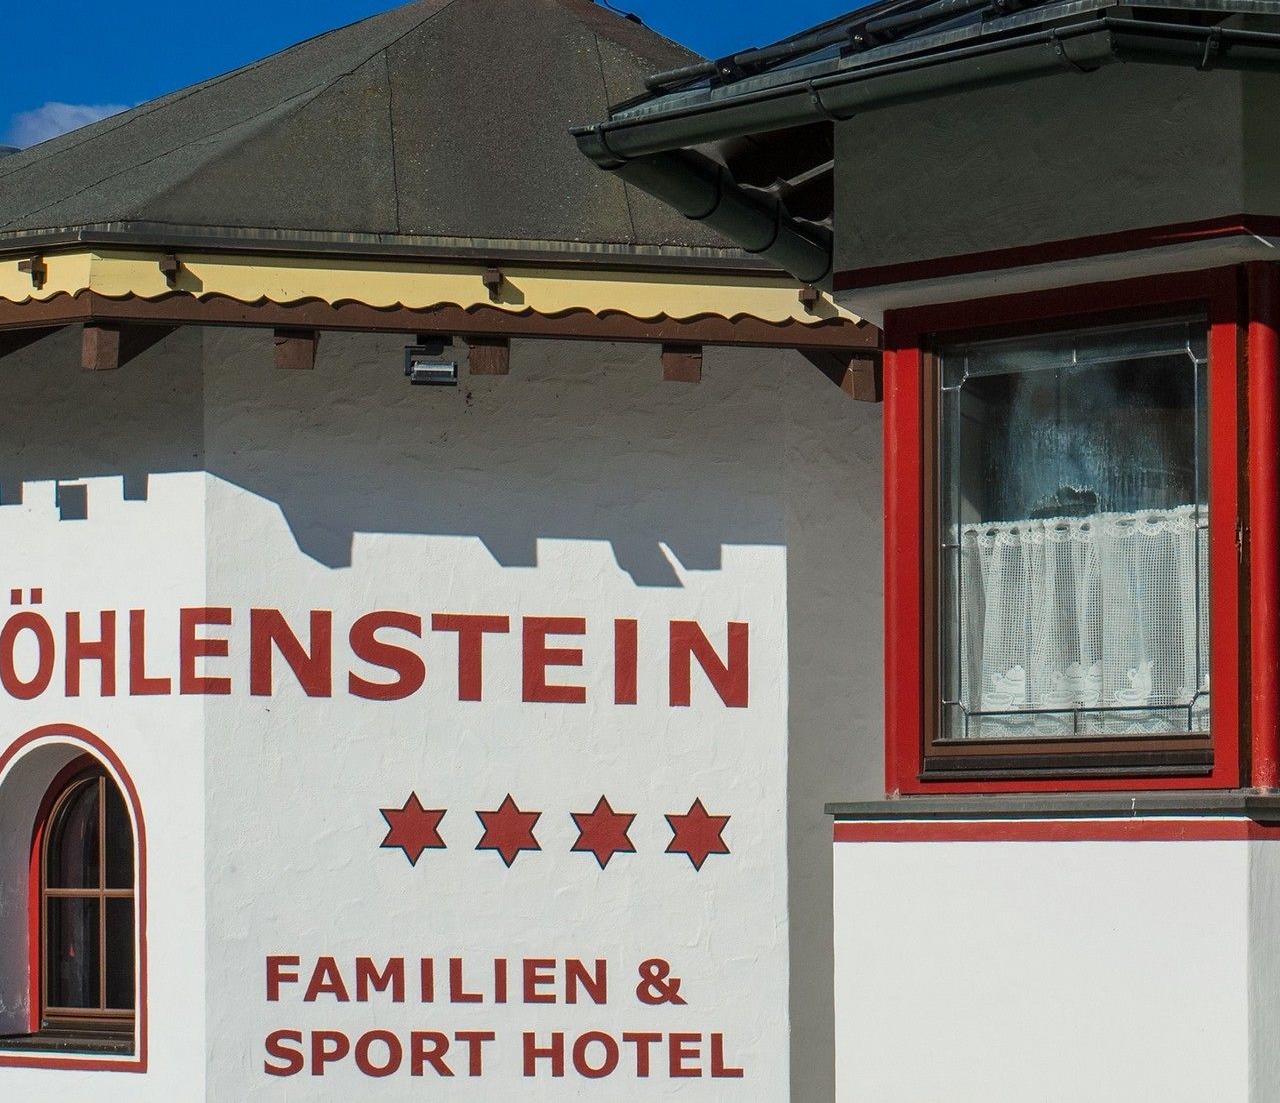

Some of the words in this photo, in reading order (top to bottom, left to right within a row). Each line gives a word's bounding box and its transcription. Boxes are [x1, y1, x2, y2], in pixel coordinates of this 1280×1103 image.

[265, 955, 608, 1004] FAMILIEN
[635, 958, 687, 1005] &
[264, 1029, 496, 1077] SPORT
[523, 1031, 744, 1078] HOTEL
